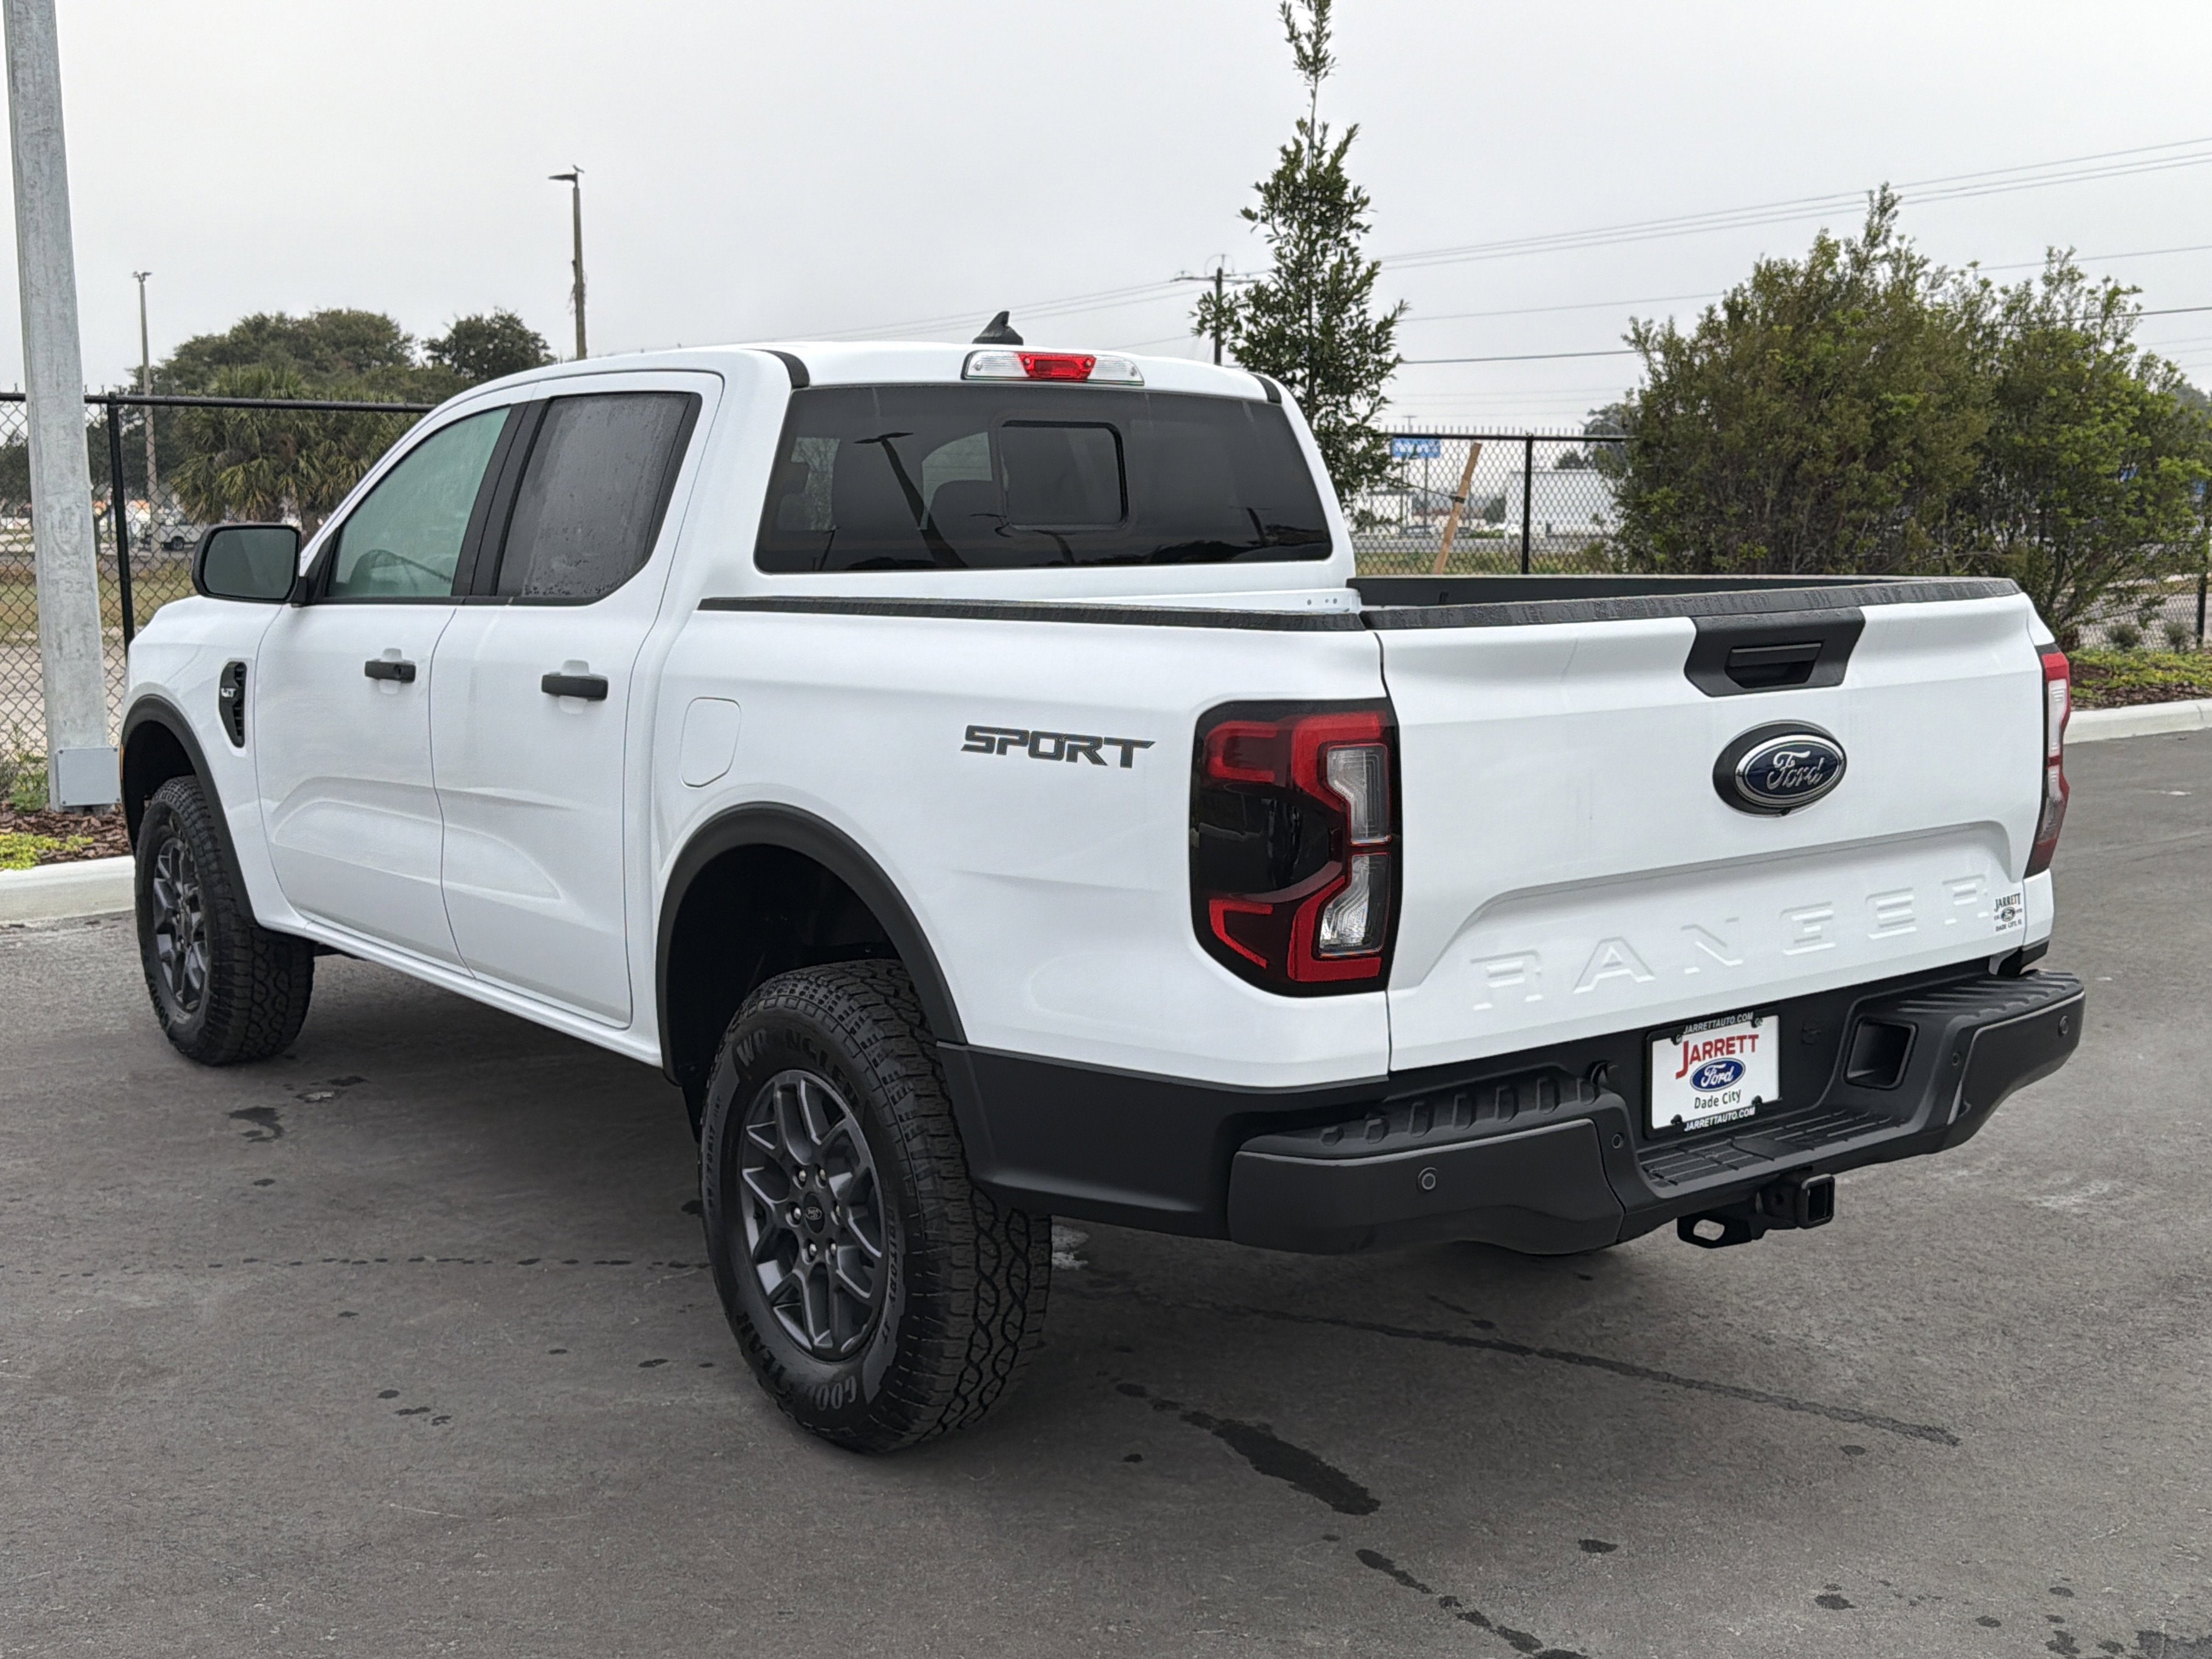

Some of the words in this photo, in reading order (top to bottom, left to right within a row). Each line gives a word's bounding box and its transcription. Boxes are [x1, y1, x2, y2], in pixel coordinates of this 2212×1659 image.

[961, 725, 1156, 769] SPORT
[1766, 750, 1826, 791] Ford
[1470, 875, 1989, 1012] RANGER
[1683, 1012, 1754, 1035] JARRETTAUTO.COM
[736, 1028, 860, 1108] WRNGLER
[1675, 1034, 1759, 1080] JARRETT
[1701, 1063, 1734, 1087] Ford
[1684, 1107, 1756, 1132] JARRETTAUTO.COM
[1694, 1095, 1719, 1109] Dade
[1722, 1089, 1741, 1104] City
